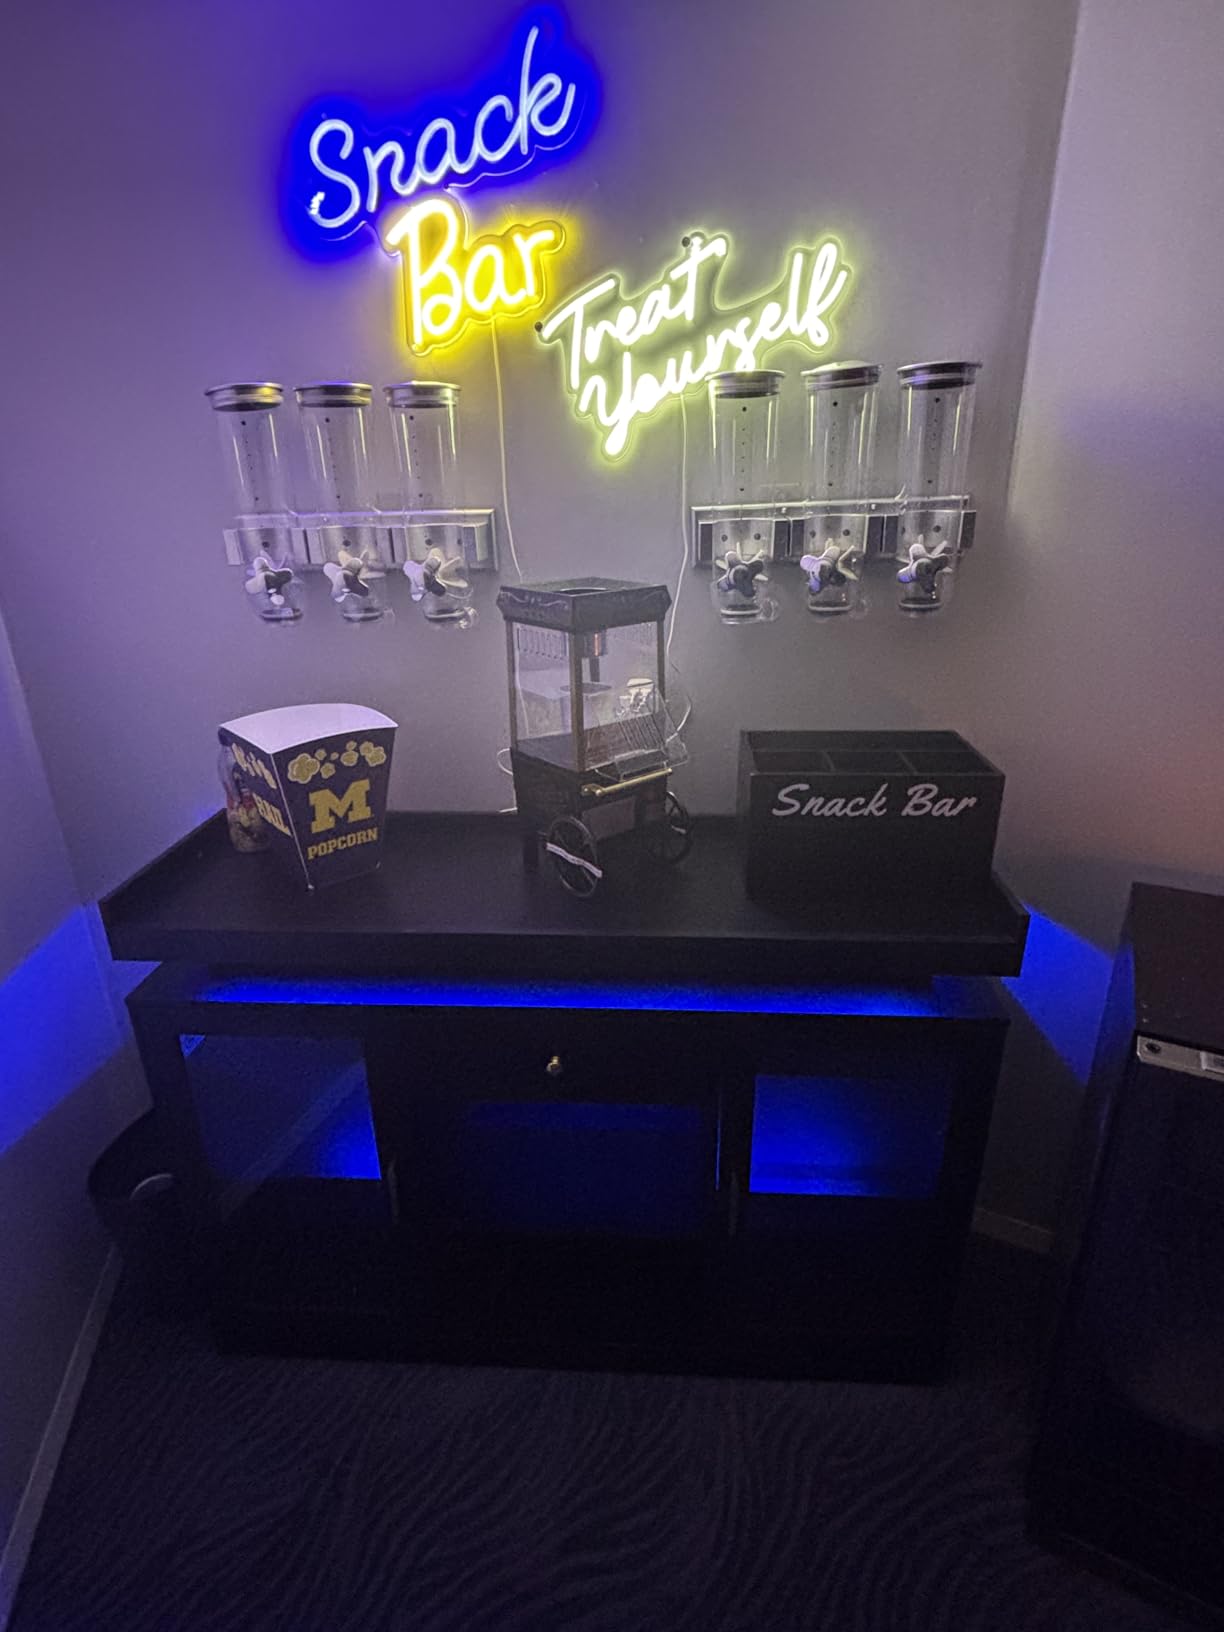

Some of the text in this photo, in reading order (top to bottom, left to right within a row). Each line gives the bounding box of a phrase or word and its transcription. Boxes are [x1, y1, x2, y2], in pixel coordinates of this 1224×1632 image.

[309, 26, 576, 229] Snack
[385, 197, 555, 350] Bar
[546, 236, 727, 390] Treat
[579, 243, 848, 456] Yourself
[307, 827, 379, 861] POPCORN
[308, 778, 375, 834] M
[772, 782, 977, 817] Snack Bar
